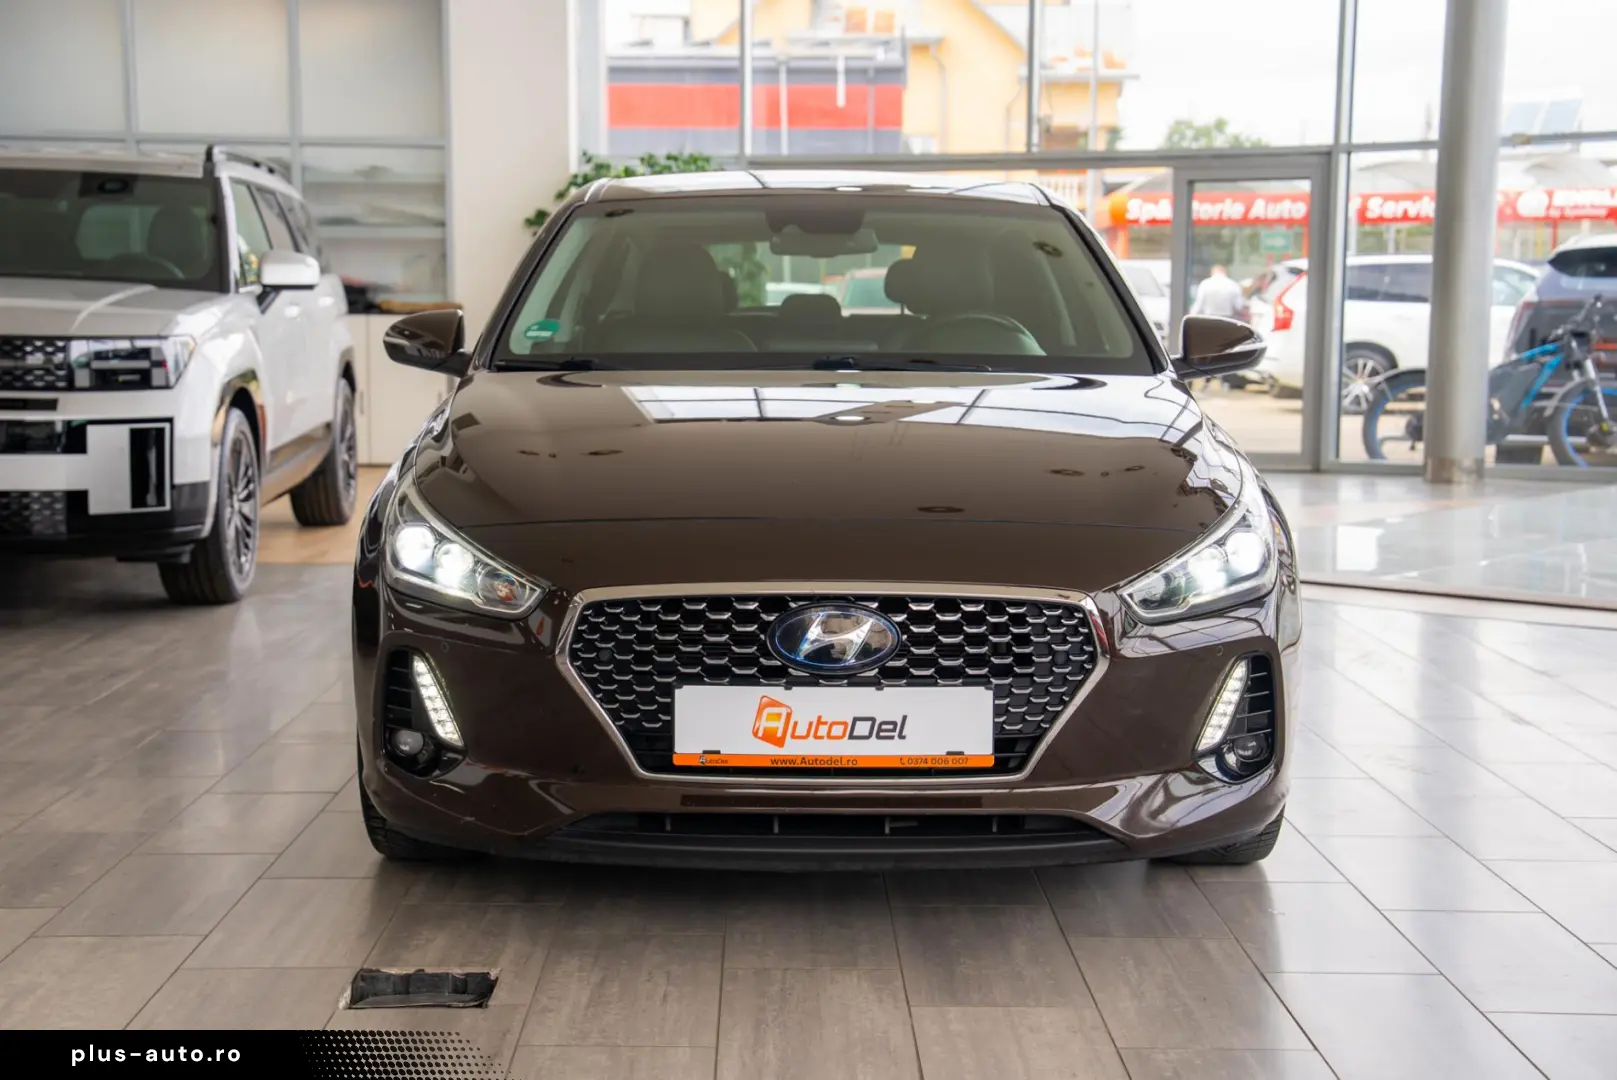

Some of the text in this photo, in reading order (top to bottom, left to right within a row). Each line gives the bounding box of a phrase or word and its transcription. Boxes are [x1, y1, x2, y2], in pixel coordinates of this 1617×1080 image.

[1247, 198, 1307, 220] Auto
[753, 696, 908, 747] AutoDel
[770, 757, 858, 766] www.Autodel.ro
[907, 757, 928, 765] 0374
[951, 757, 969, 765] 007
